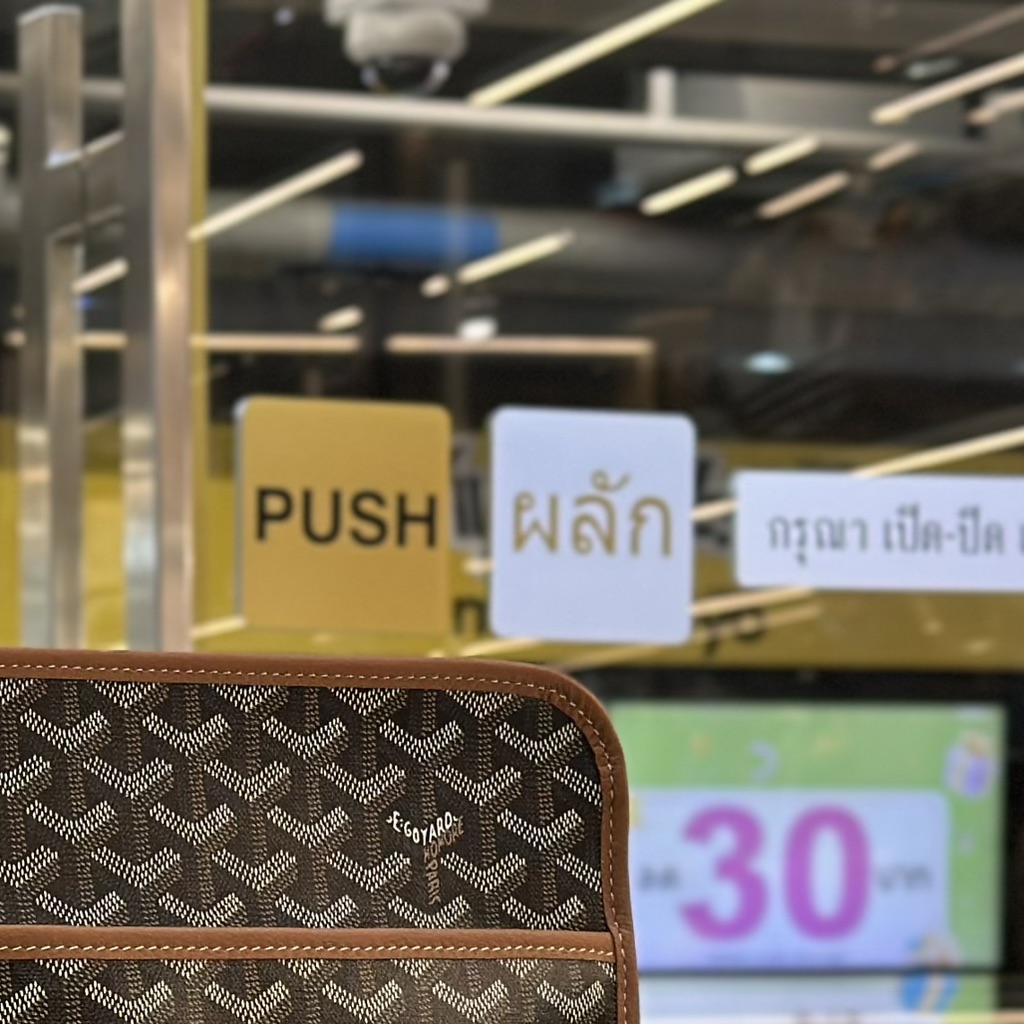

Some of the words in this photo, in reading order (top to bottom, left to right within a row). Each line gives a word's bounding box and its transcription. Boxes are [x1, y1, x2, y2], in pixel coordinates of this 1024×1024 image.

[255, 484, 438, 548] PUSH
[513, 468, 673, 557] ผลัก
[769, 515, 869, 567] กรุณา
[678, 803, 874, 943] 30
